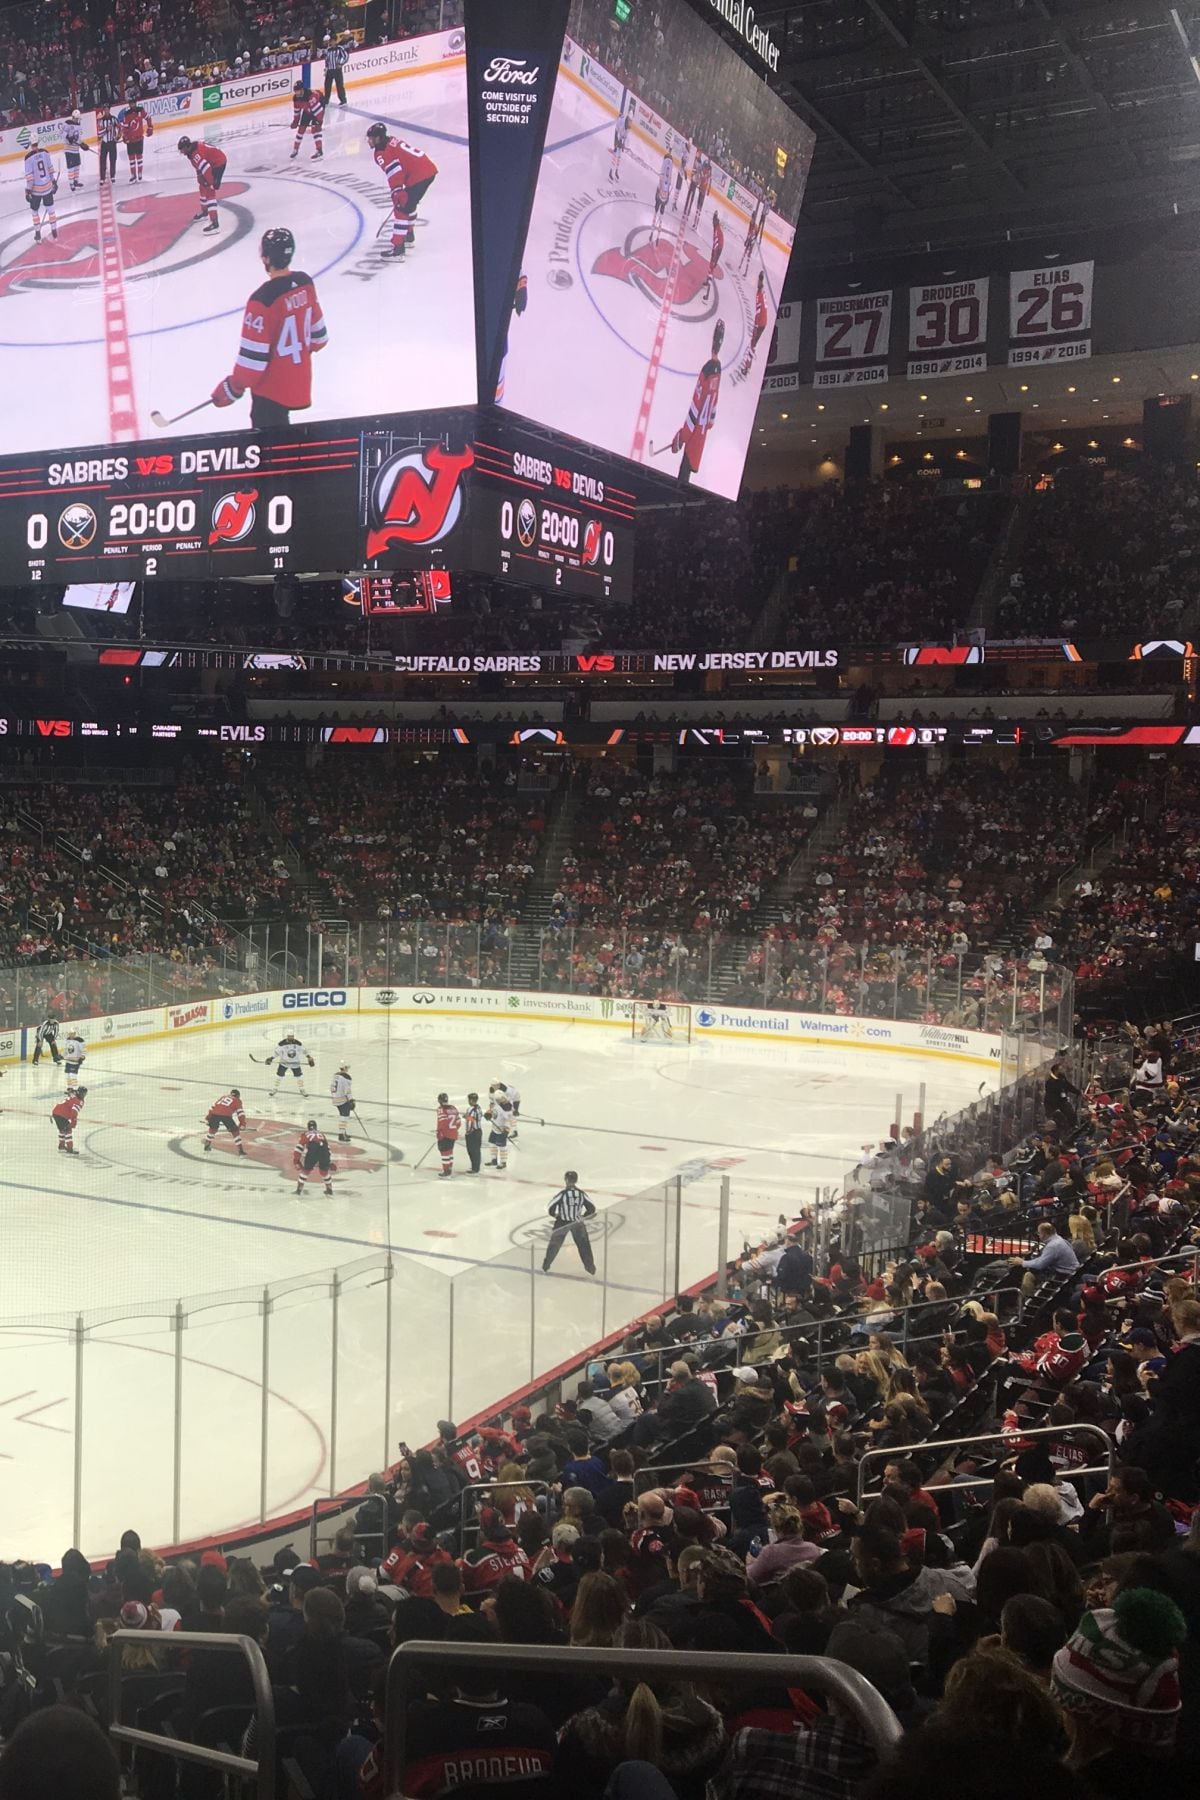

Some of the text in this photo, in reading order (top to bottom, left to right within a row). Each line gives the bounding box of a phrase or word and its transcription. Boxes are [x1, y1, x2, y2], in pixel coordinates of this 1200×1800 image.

[745, 6, 781, 72] Center
[343, 46, 419, 75] nvestorsBank
[484, 57, 539, 85] Ford
[203, 76, 290, 107] enterprise
[482, 91, 537, 103] COME VISIT US
[486, 102, 532, 113] OUTSIDE OF
[487, 113, 529, 124] SECTION 21
[37, 124, 54, 135] EAST
[37, 159, 47, 178] 9
[1033, 269, 1071, 287] ELIAS
[922, 282, 976, 301] BRODEUR
[1017, 282, 1085, 335] 26
[916, 296, 980, 348] 30
[823, 309, 882, 358] 27
[1011, 344, 1088, 363] 1994 2016
[910, 356, 983, 375] 1990 2014
[770, 376, 797, 389] 2003
[817, 369, 885, 385] 1991 2004
[48, 445, 261, 486] SABRES VS DEVILS
[513, 451, 604, 502] SABRES VS DEVILS
[27, 495, 293, 549] 0 20:00 0
[501, 501, 614, 566] 0 20:00 0
[103, 541, 202, 555] PENALTY PERIOD PENALTY
[31, 557, 284, 580] 12 2 11
[555, 568, 562, 585] 2
[473, 655, 541, 672] SABRES
[576, 655, 616, 672] VS
[654, 654, 696, 671] NEW
[698, 652, 769, 670] JERSEY
[772, 650, 838, 669] DEVILS
[36, 719, 71, 737] VS
[220, 725, 265, 741] EVILS
[843, 731, 873, 741] 20:00
[235, 997, 269, 1014] Prudential
[282, 990, 347, 1009] GEICO
[440, 994, 500, 1006] INFINITI
[523, 998, 592, 1012] investorsBank
[720, 1013, 790, 1031] Prudential
[800, 1019, 892, 1038] Walmart com
[1055, 1446, 1085, 1463] ELIAS
